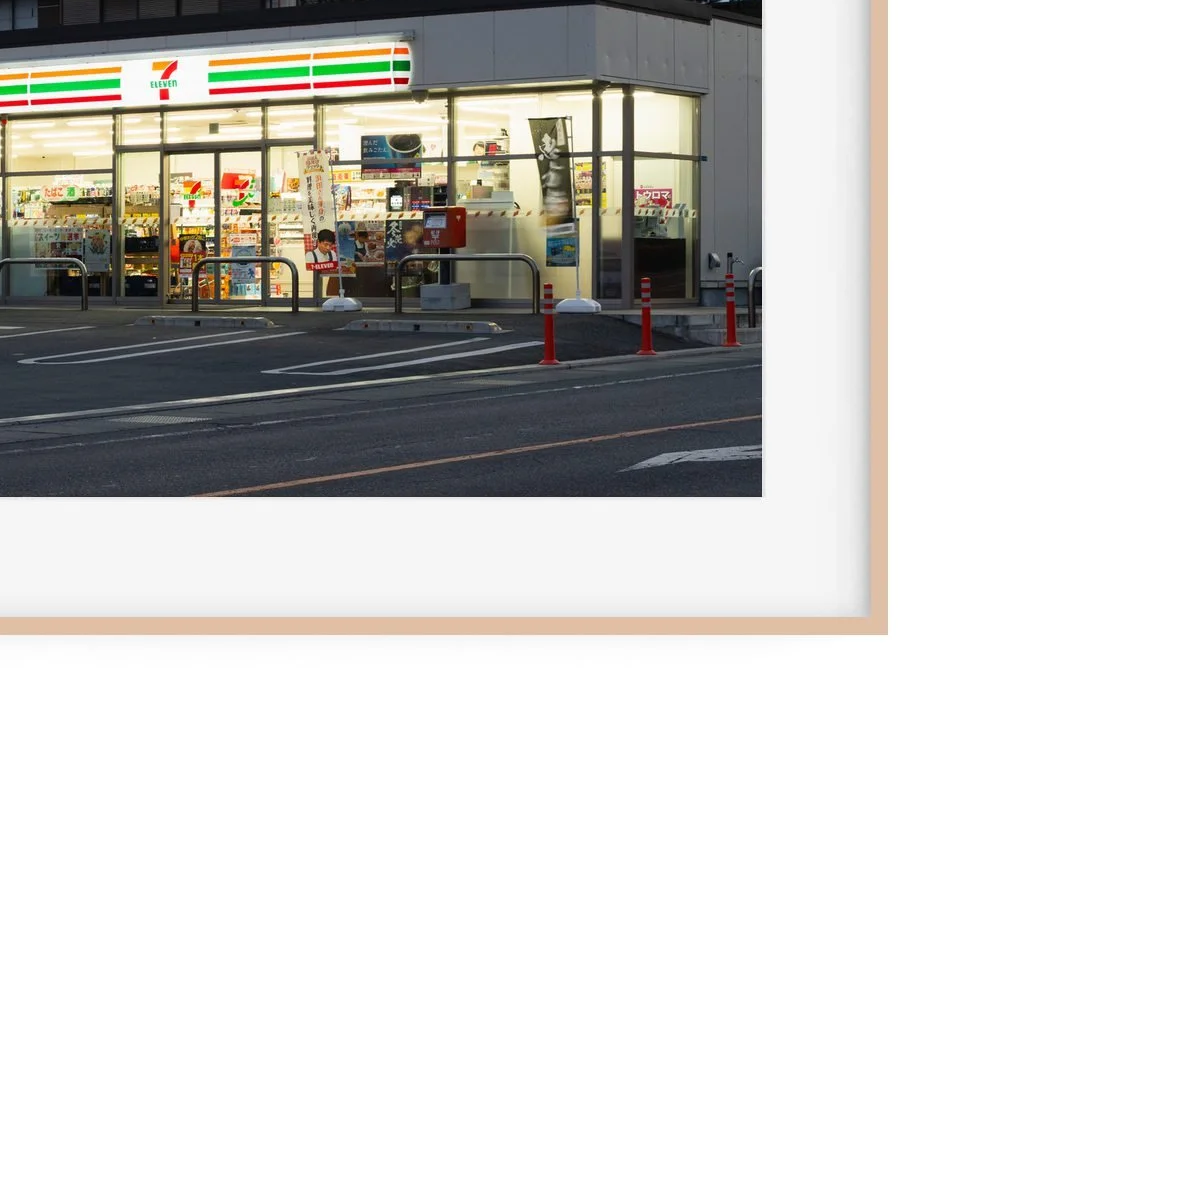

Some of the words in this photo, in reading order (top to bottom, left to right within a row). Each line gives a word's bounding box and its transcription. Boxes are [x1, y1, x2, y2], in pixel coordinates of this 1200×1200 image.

[152, 60, 178, 100] 7
[44, 187, 63, 197] たばこ
